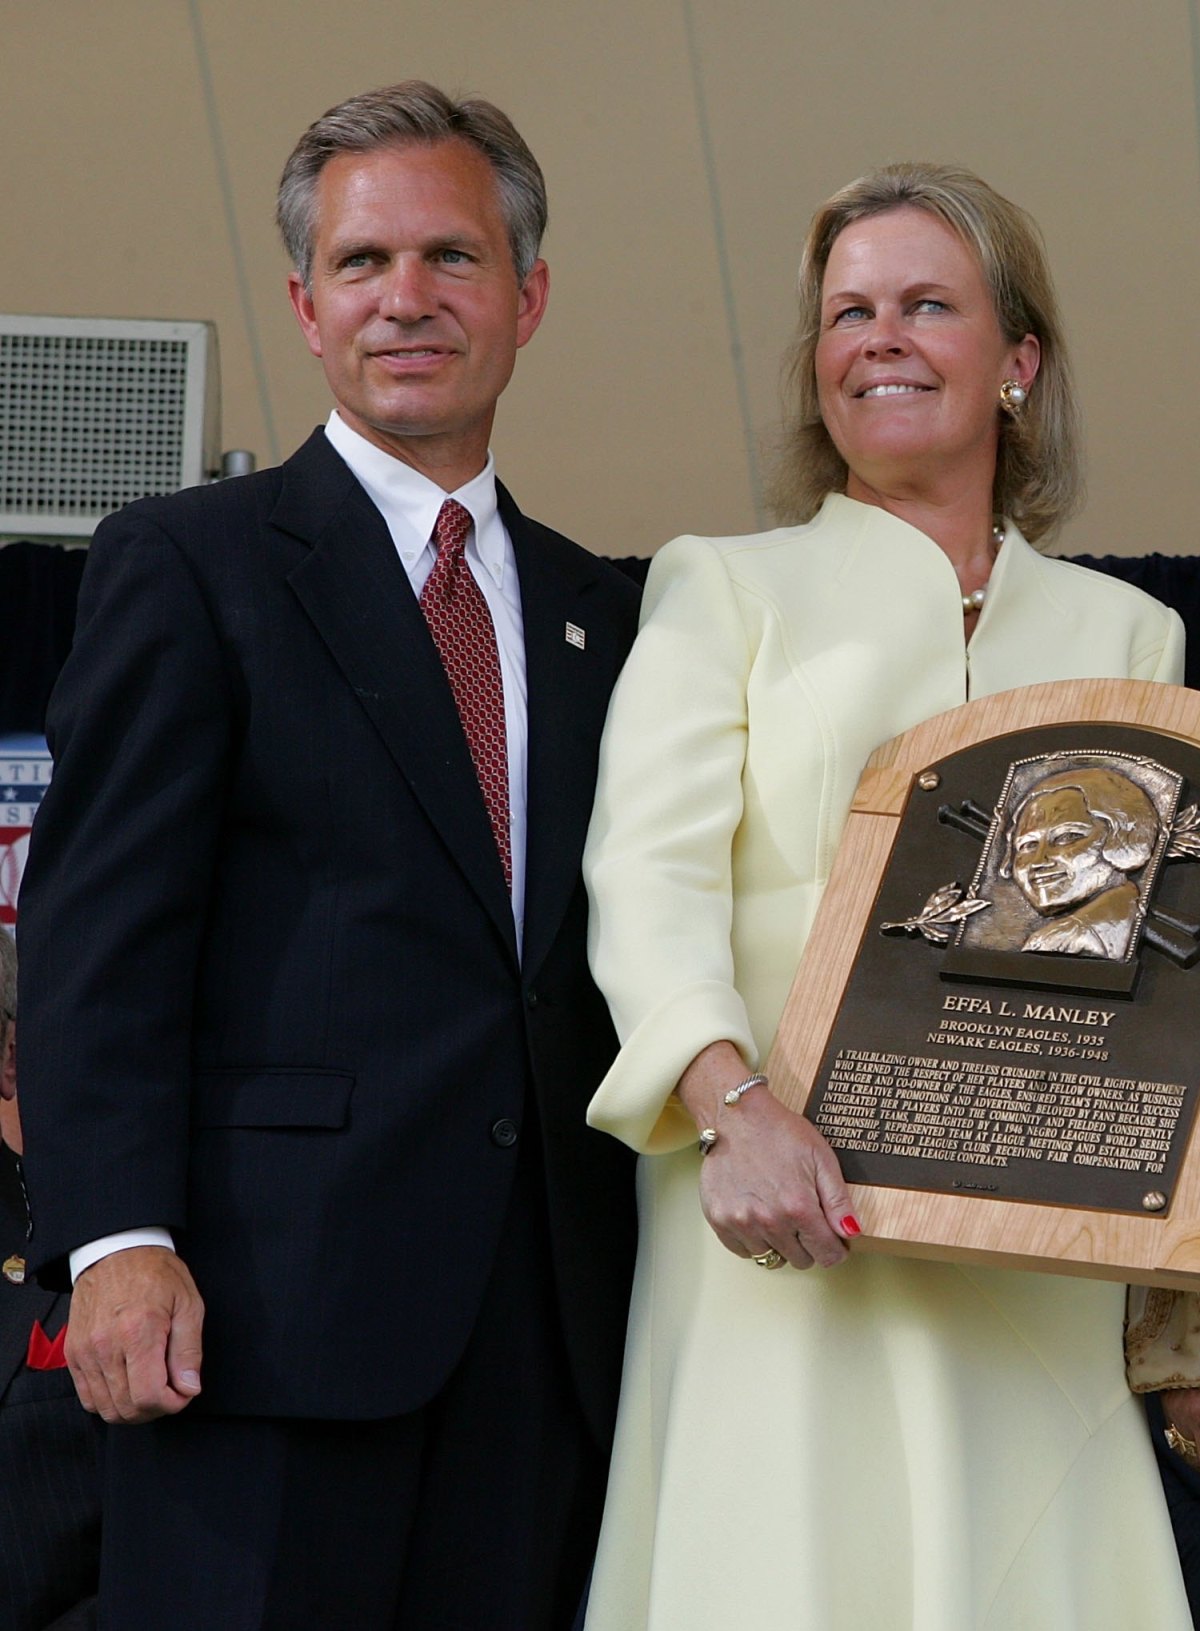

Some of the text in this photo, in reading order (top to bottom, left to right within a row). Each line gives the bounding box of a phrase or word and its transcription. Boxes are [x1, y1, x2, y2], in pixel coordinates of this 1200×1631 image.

[940, 1020, 1105, 1046] BROOKLYN EAGLES, 1935
[942, 996, 1116, 1027] EFFA L. MANLEY
[927, 1033, 1109, 1061] NEWARK EAGLES, 1936-1948
[830, 1071, 1181, 1118] MANAGER AND CO-OWNER OF THE EAGLES, ENSURED TEAM'S FINANCIAL SUCCESS
[835, 1060, 1184, 1107] WHO EARNED THE RESPECT OF HER PLAYERS AND FELLOW OWNERS. AS BUSINESS
[837, 1050, 1187, 1096] A TRAILBLAZING OWNER AND TIRELESS CRUSADER IN THE CIVIL RIGHTS MOVEMENT
[820, 1103, 1171, 1151] COMPETITIVE TEAMS, HIGHLIGHTED BY A 1946 NEGRO LEAGUES WORLD SERIES
[823, 1092, 1175, 1140] INTEGRATED HER PLAYERS INTO THE COMMUNITY AND FIELDED CONSISTENTLY
[828, 1081, 1177, 1129] WITH CREATIVE PROMOTIONS AND ADVERTISING. BELOVED BY FANS BECAUSE SHE
[816, 1114, 1167, 1162] CHAMPIONSHIP. REPRESENTED TEAM AT LEAGUE MEETINGS AND ESTABLISHED A
[847, 1139, 879, 1152] SIGNED
[880, 1143, 892, 1154] TO
[892, 1145, 921, 1157] MAJOR
[921, 1148, 957, 1161] LEAGUE
[957, 1152, 1008, 1167] CONTRACTS.
[867, 1131, 881, 1141] OF
[883, 1132, 915, 1145] NEGRO
[918, 1136, 959, 1150] LEAGUES
[963, 1141, 992, 1153] CLUBS
[995, 1145, 1043, 1160] RECEIVING
[1047, 1151, 1069, 1163] FAIR
[1073, 1154, 1141, 1171] COMPENSATION
[1145, 1162, 1165, 1173] FOR
